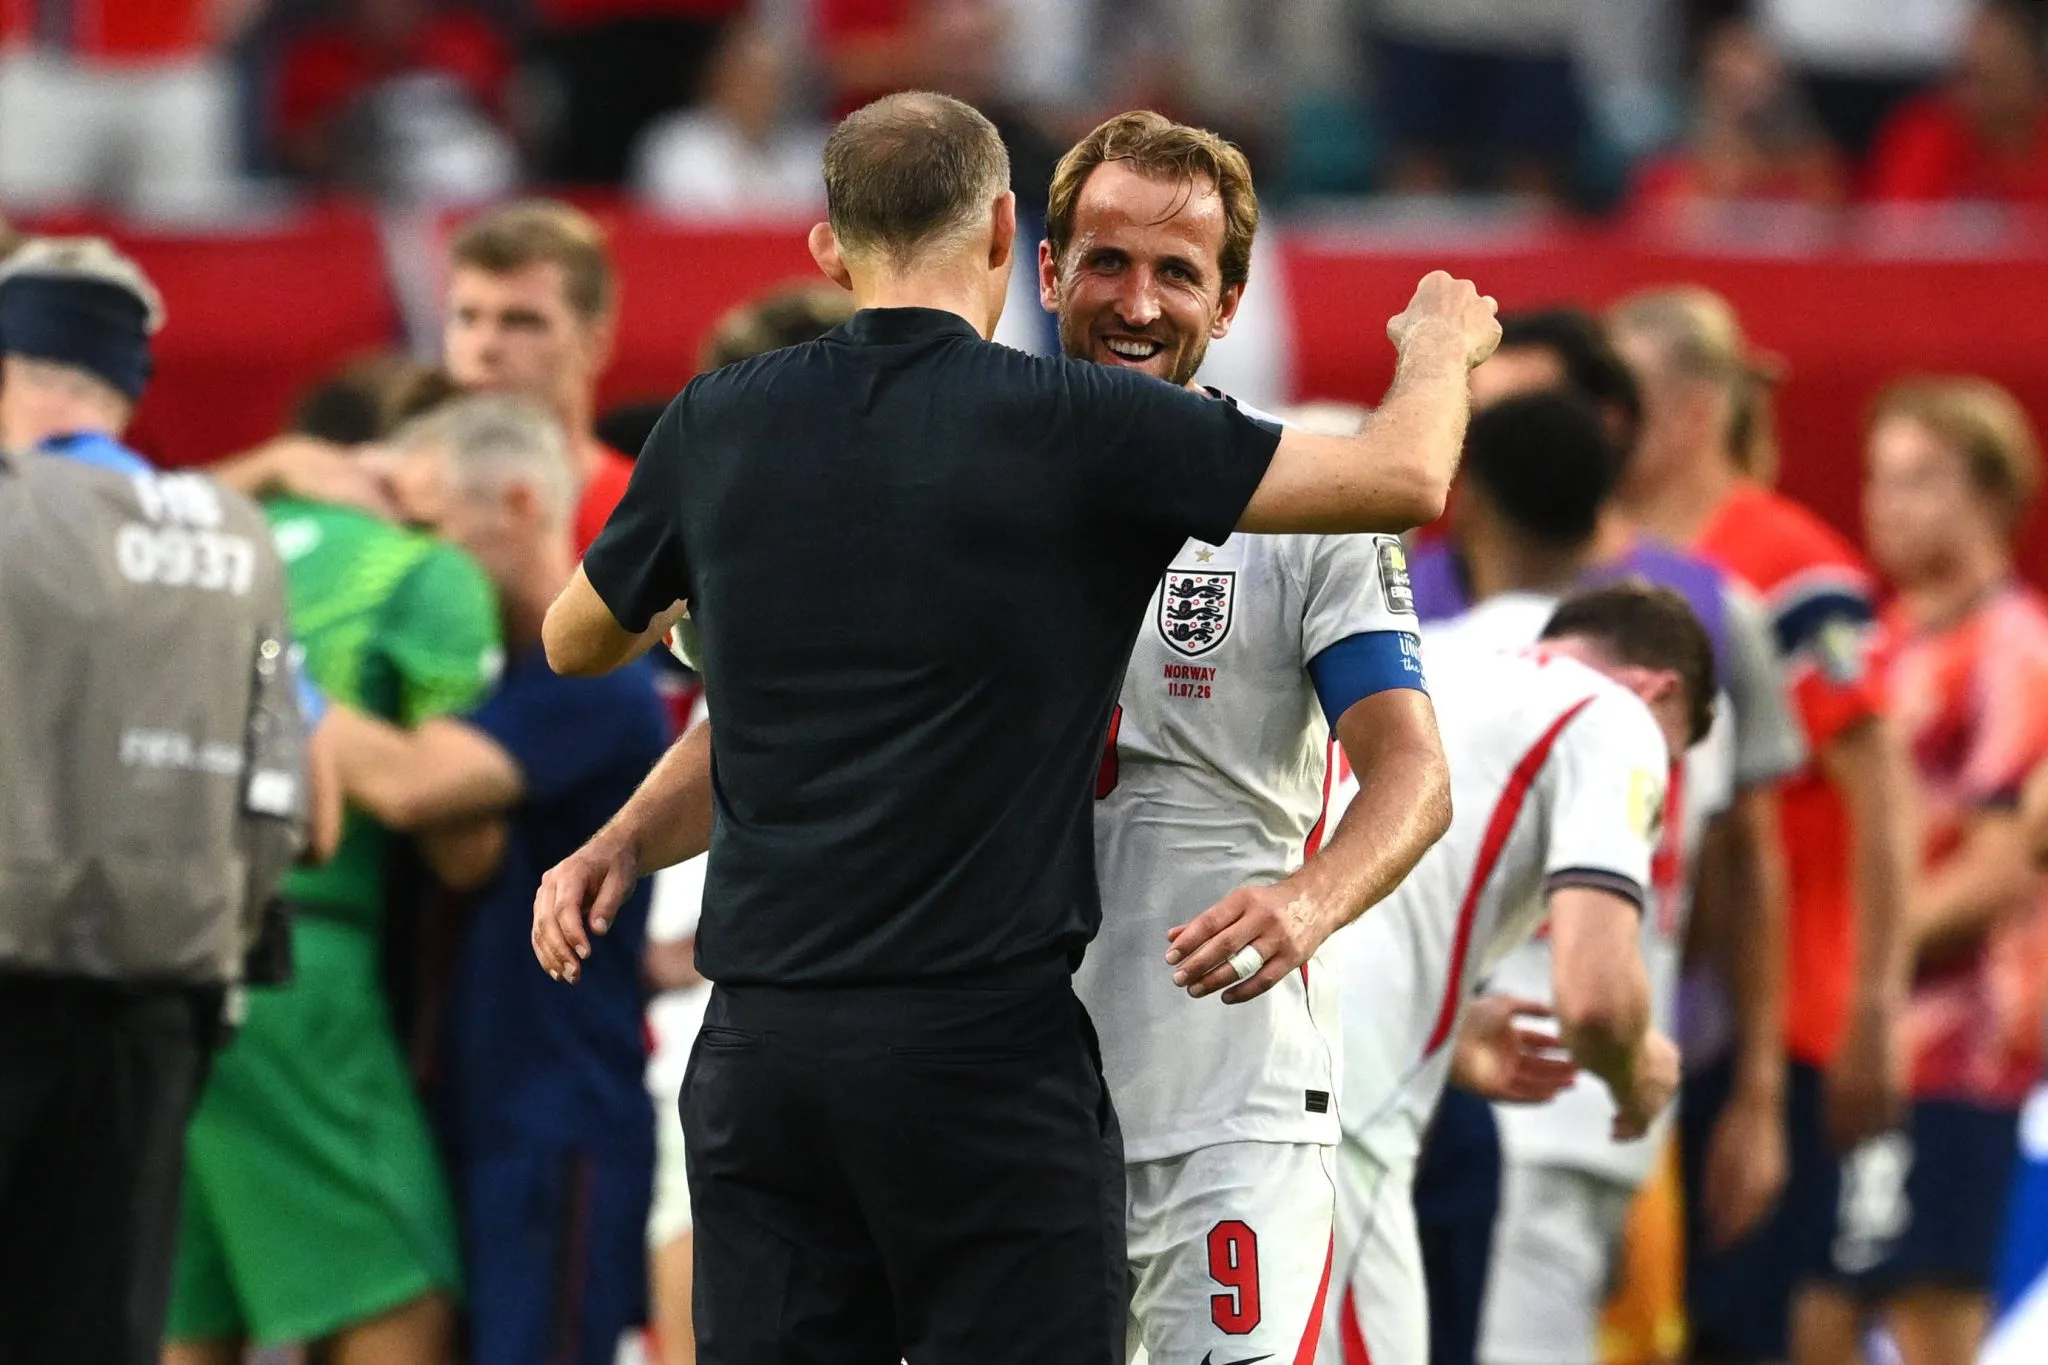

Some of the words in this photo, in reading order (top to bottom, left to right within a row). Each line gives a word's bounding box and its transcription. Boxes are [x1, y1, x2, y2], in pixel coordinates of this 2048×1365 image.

[117, 522, 256, 597] 0937
[1164, 664, 1217, 681] NORWAY
[1168, 682, 1212, 699] 11.07.26
[1207, 1219, 1262, 1335] 9
